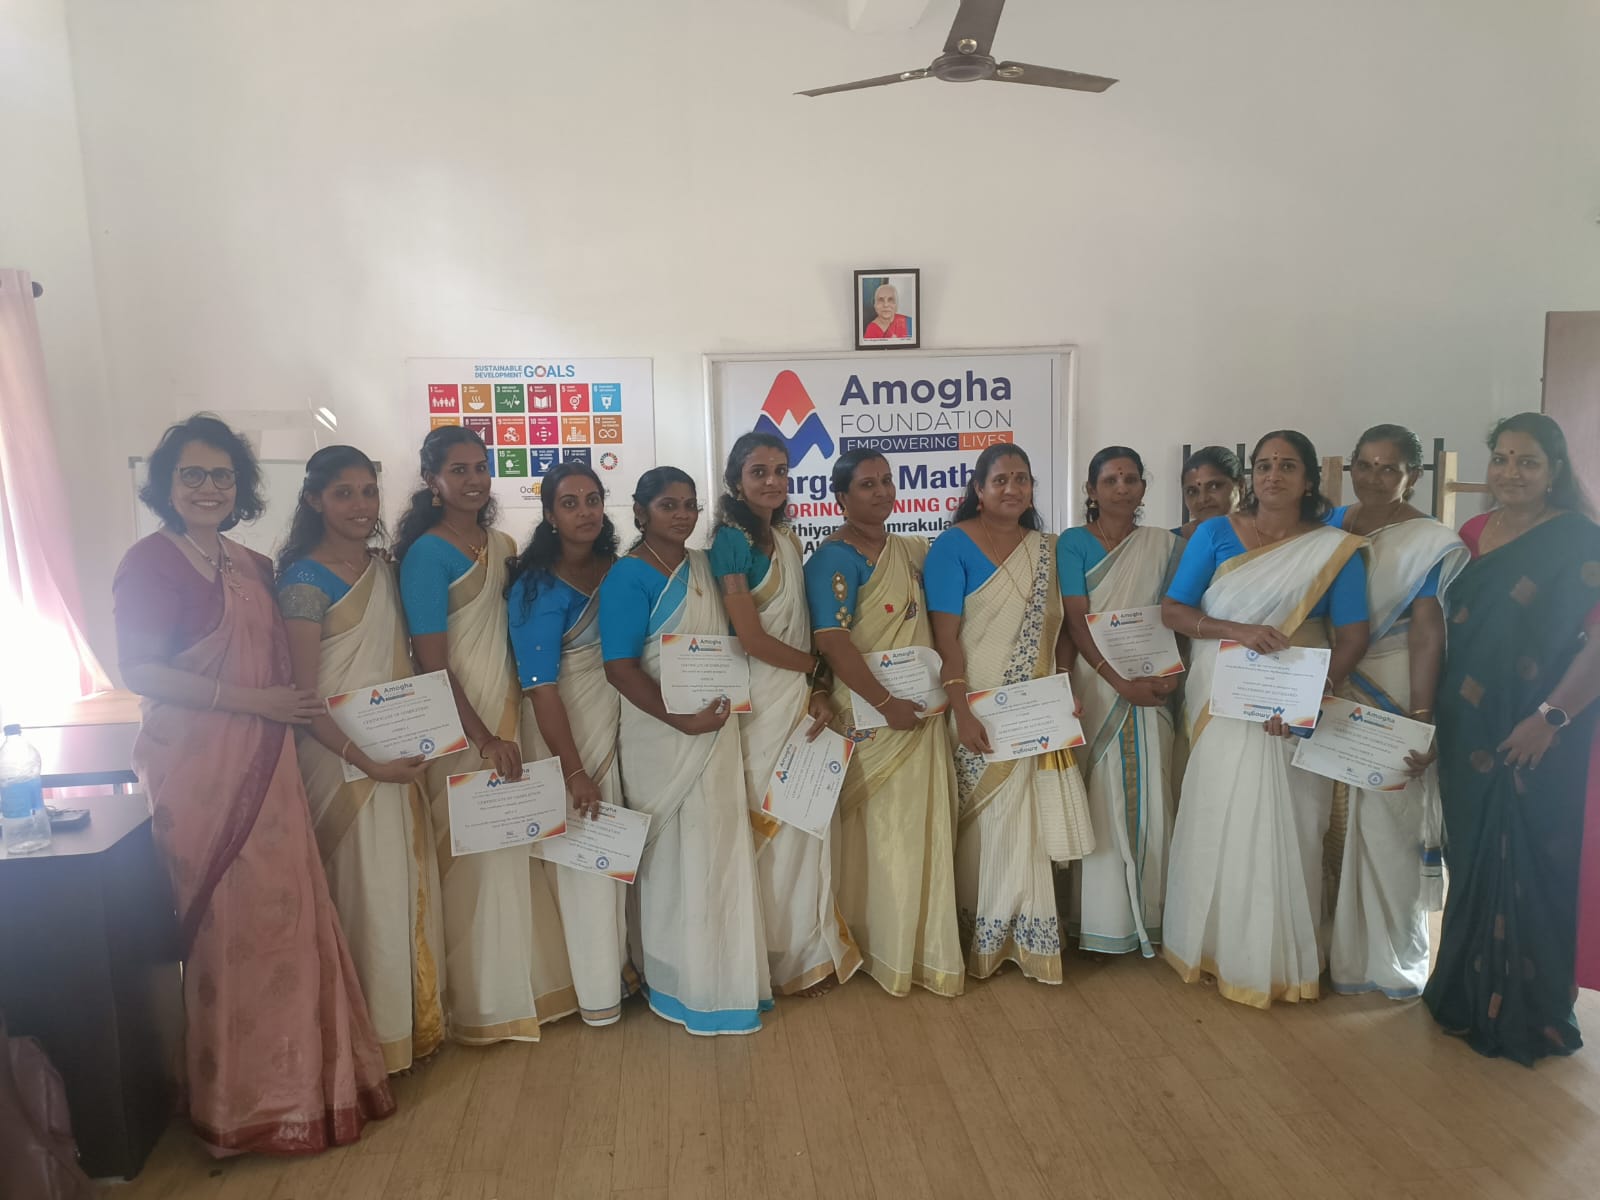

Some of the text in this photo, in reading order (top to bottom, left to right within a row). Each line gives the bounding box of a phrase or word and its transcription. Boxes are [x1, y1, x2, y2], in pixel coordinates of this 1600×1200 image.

[524, 365, 575, 378] GOALS
[840, 370, 1011, 409] Amogha
[840, 408, 1012, 434] FOUNDATION
[846, 434, 1007, 450] EMPOWERING LIVES
[898, 462, 977, 490] Math
[893, 498, 940, 514] NING
[884, 518, 952, 532] mrakula
